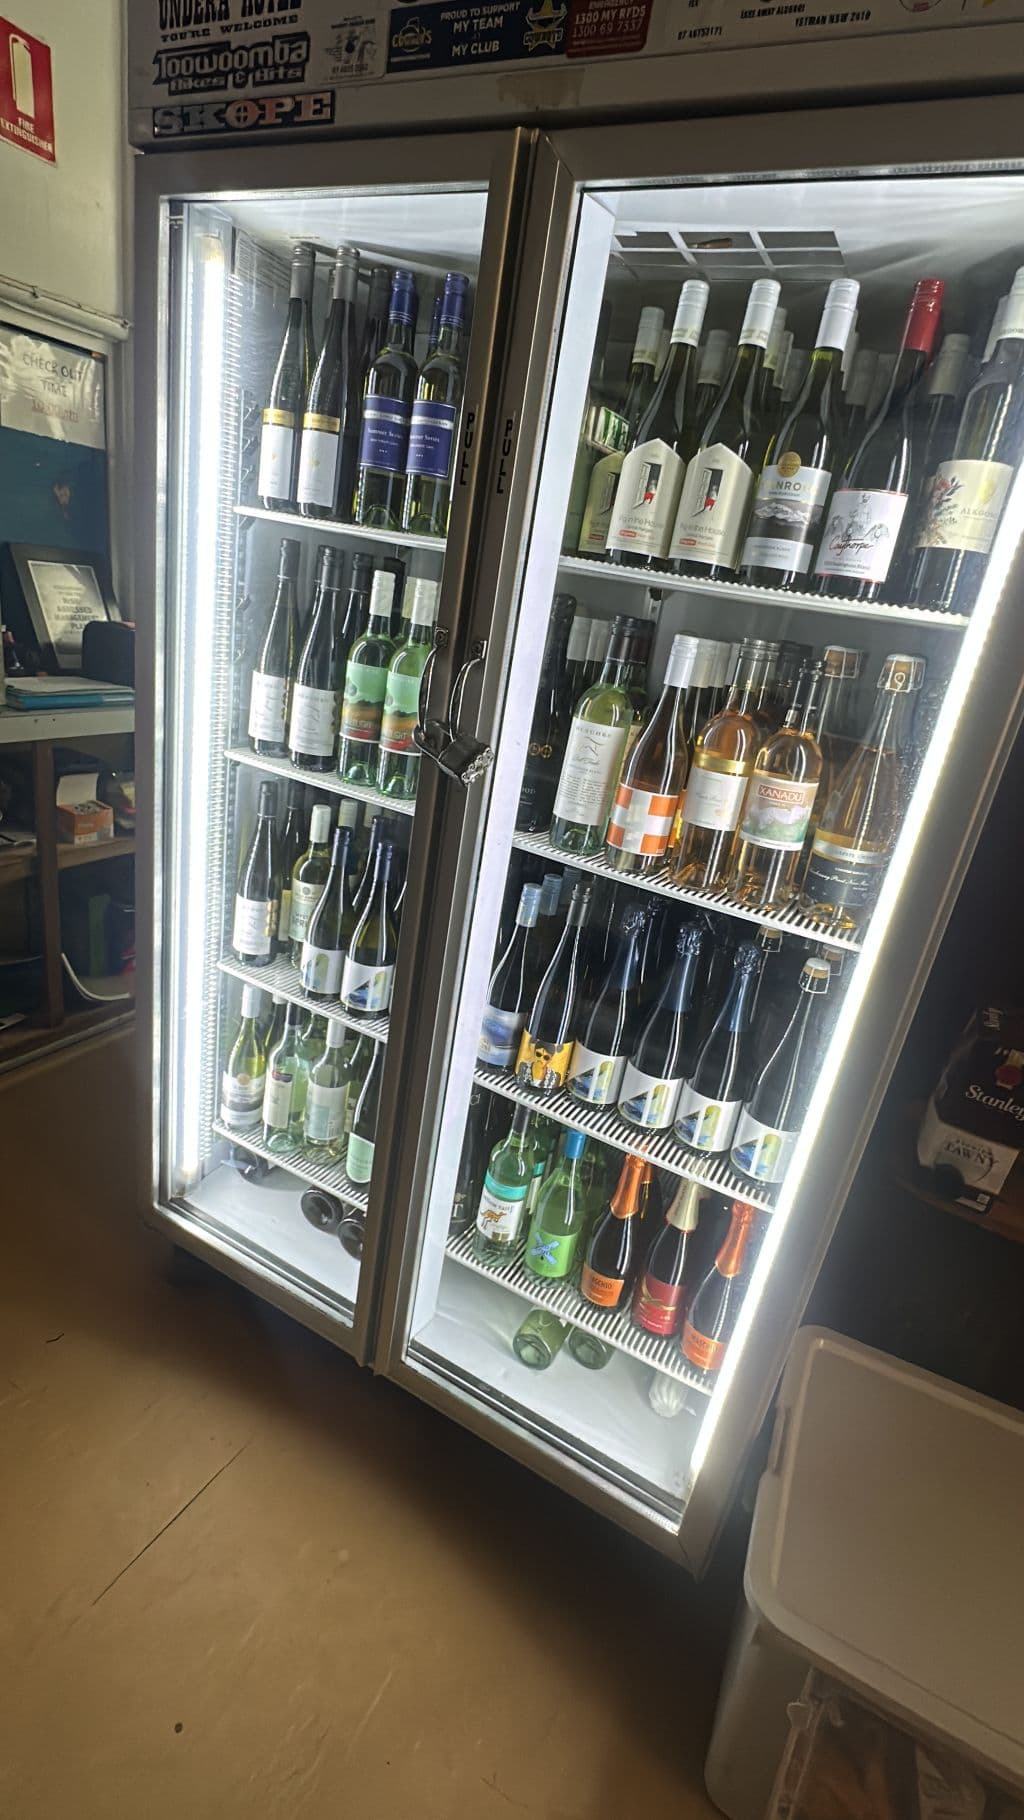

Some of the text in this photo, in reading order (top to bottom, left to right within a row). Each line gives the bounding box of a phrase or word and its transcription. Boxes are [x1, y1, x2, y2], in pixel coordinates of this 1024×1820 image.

[440, 1, 520, 21] PROUD TO SUPPORT
[453, 15, 503, 33] MY TEAM
[575, 9, 599, 24] 1300
[601, 8, 618, 22] MY
[160, 15, 298, 42] YOU'RE WELCOME
[157, 38, 306, 79] Toowoomba
[452, 40, 500, 57] MY CLUB
[154, 91, 333, 135] SKOPE
[23, 353, 82, 382] CHECK OUT
[460, 412, 475, 486] PULL
[496, 419, 513, 494] PULL
[758, 785, 803, 802] XANADU
[965, 1084, 1024, 1121] Stanley
